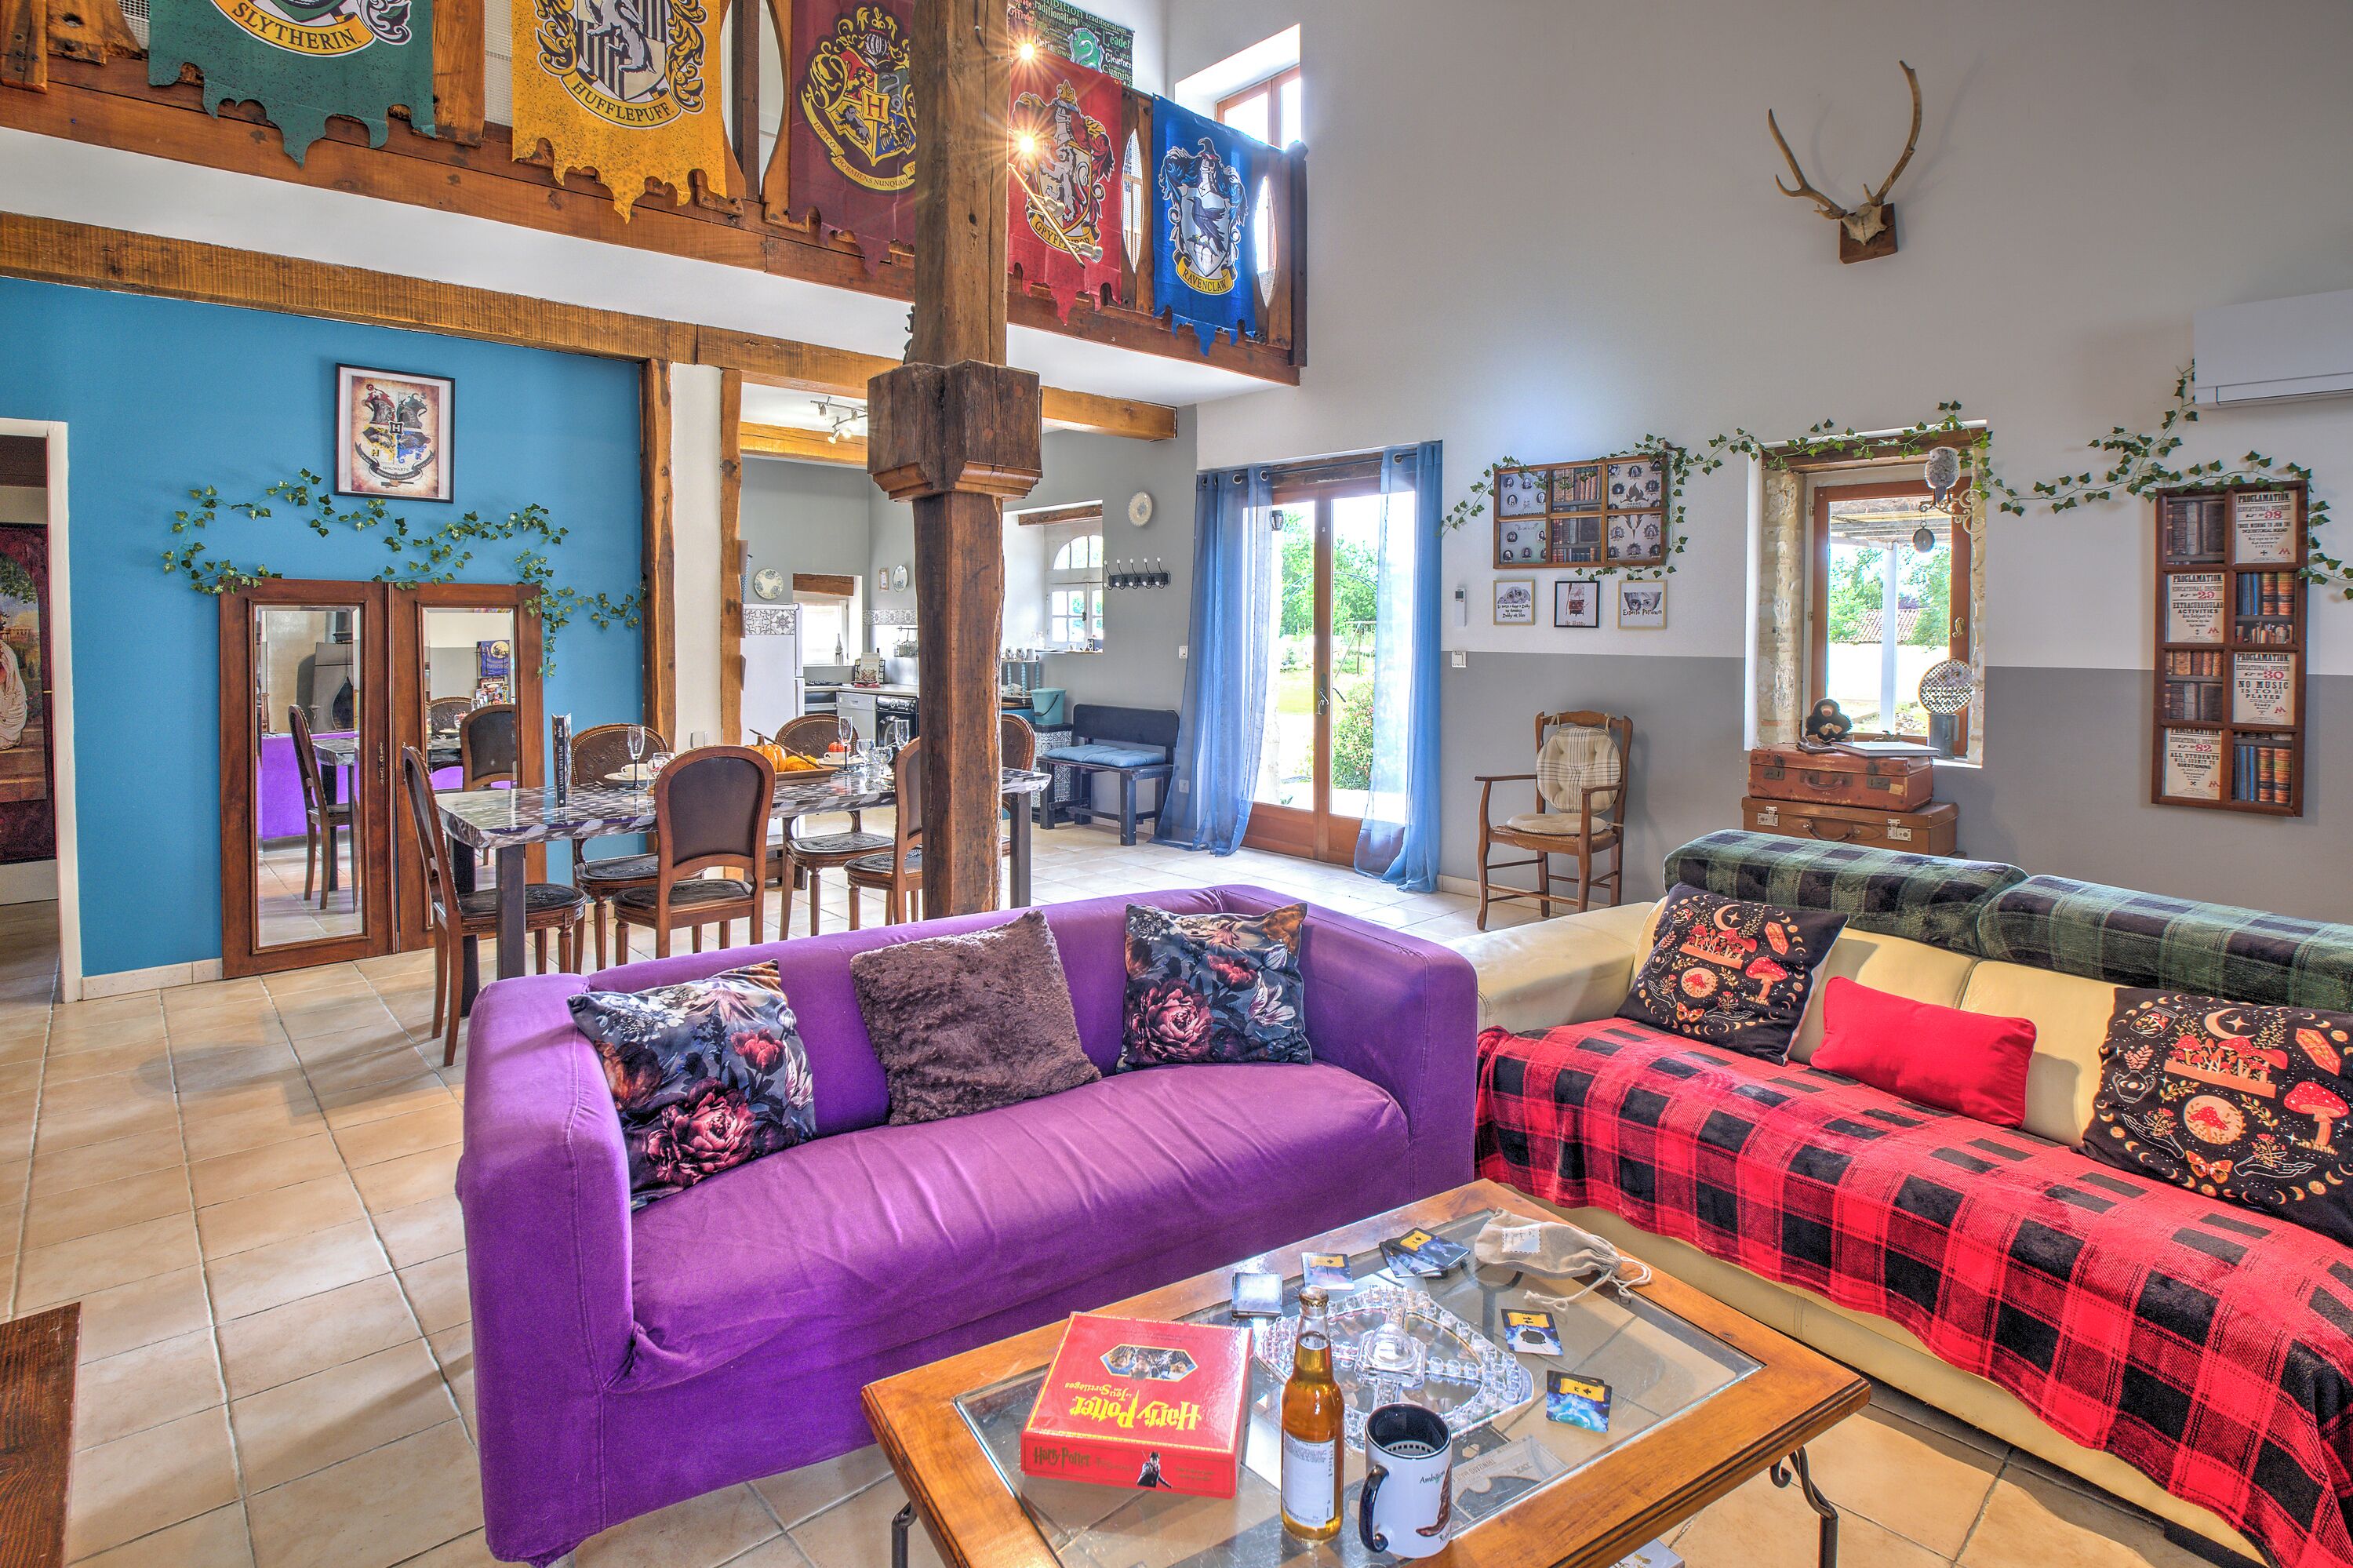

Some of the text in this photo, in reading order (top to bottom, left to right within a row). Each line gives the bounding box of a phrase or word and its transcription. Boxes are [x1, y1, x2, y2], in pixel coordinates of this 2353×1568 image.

[231, 2, 358, 50] SLYTHERIN
[572, 81, 671, 122] HUFFLEPUFF
[867, 94, 885, 120] H
[813, 122, 836, 148] DRACO
[835, 158, 908, 188] DORMIENS NUNQUAM
[1182, 268, 1227, 292] RAVENCLAW
[1642, 608, 1662, 617] Patronum
[2264, 671, 2284, 679] 30
[1064, 1381, 1111, 1395] Sortilèges
[1109, 1387, 1129, 1401] Jeu
[1069, 1389, 1202, 1431] Harry Potter
[1034, 1446, 1060, 1465] Harry
[1061, 1446, 1091, 1469] Potter
[1420, 1470, 1445, 1484] Ambition
